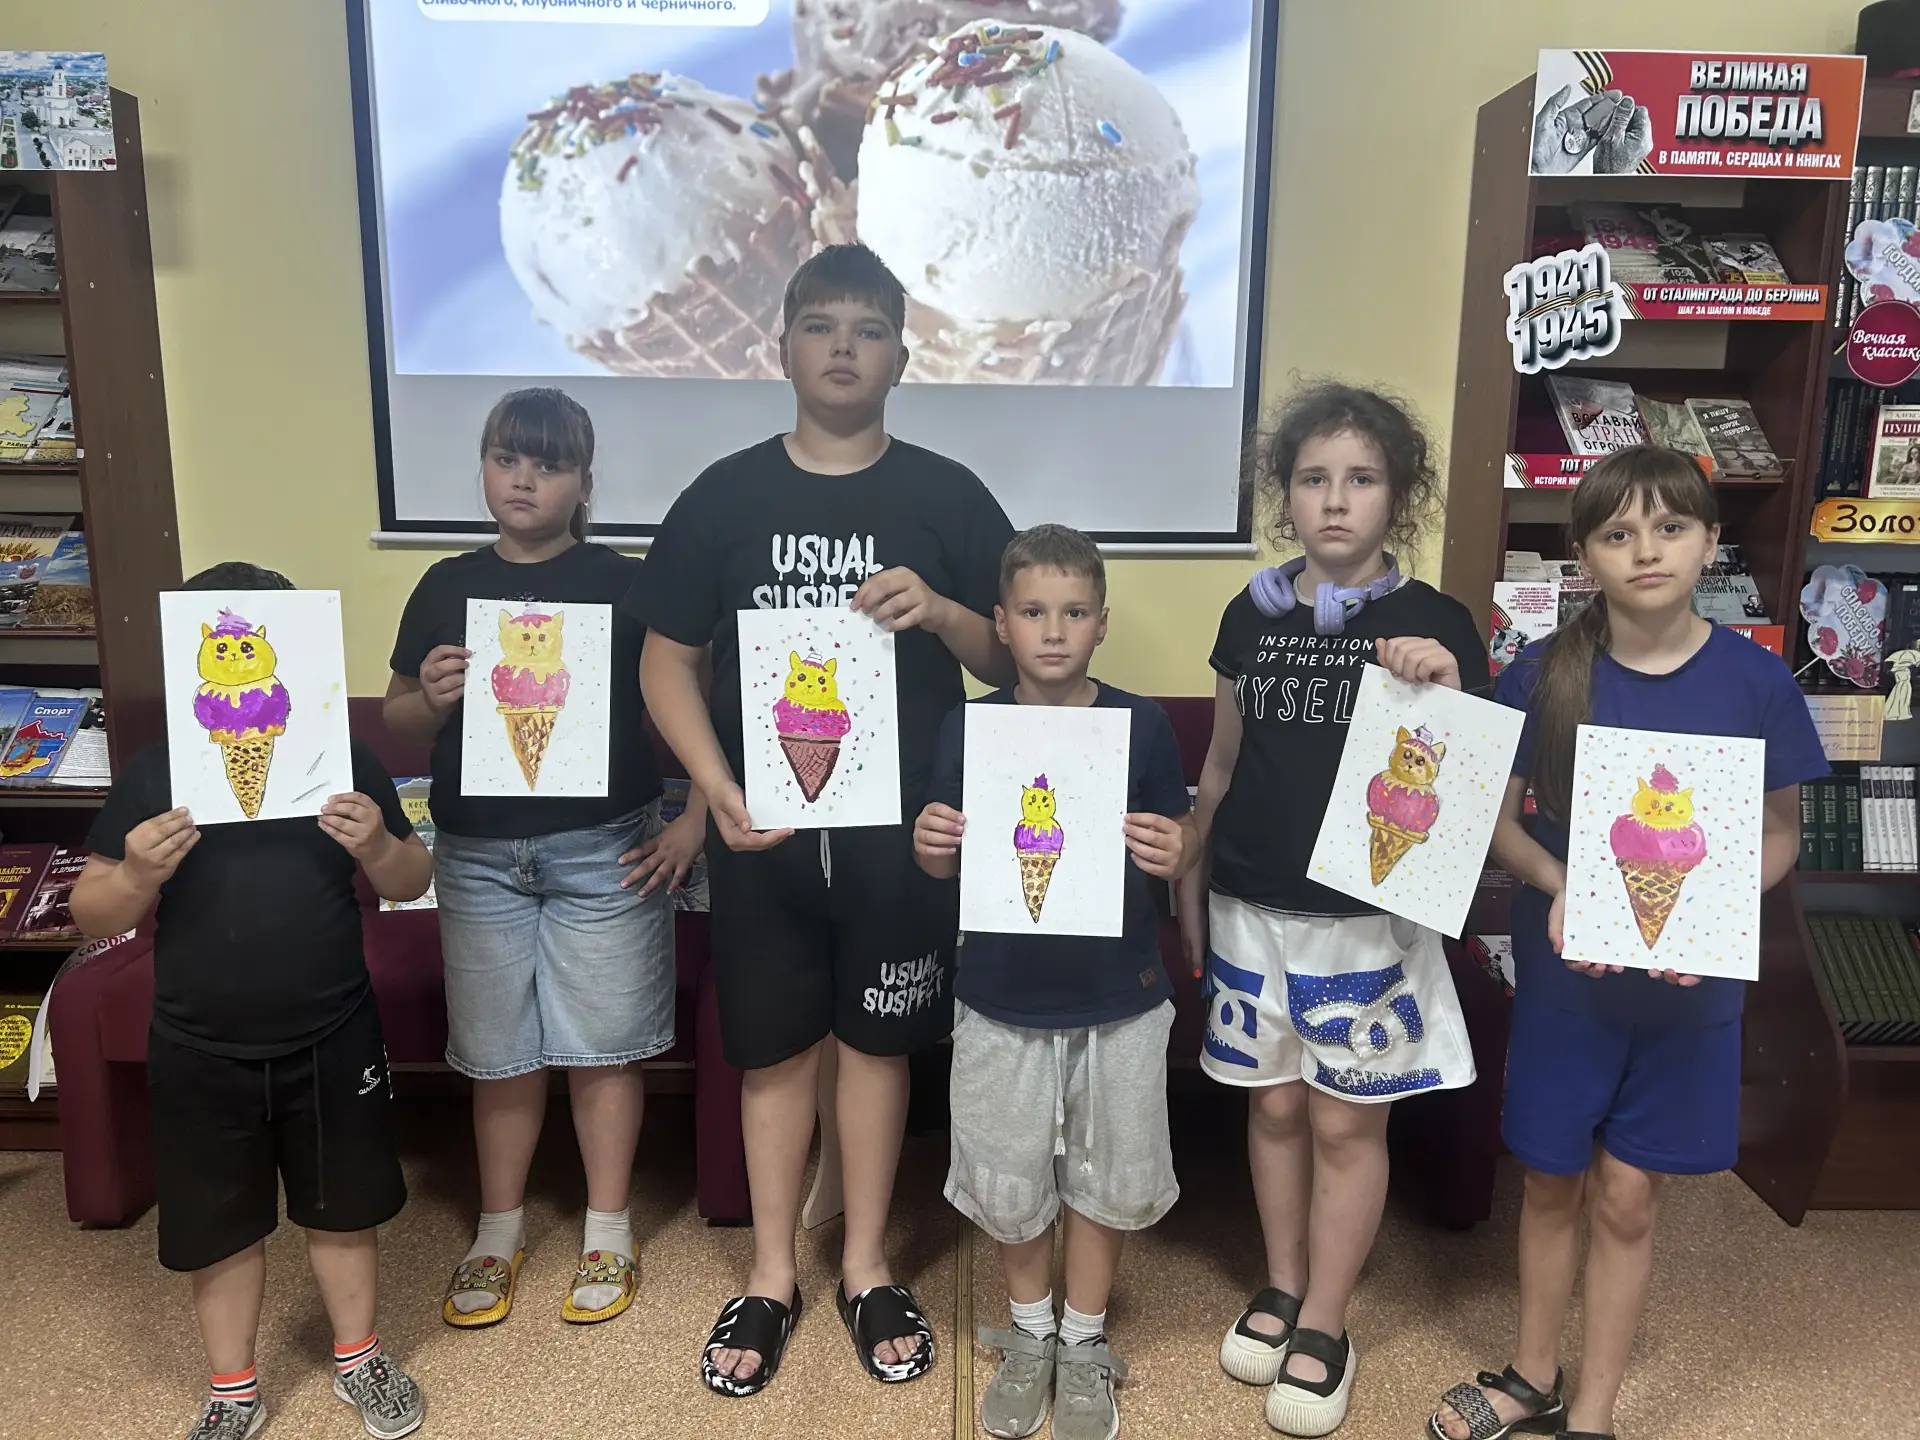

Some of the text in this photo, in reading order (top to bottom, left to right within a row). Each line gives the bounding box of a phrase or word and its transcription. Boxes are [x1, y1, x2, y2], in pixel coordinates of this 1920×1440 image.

[641, 0, 736, 12] черничного.
[1690, 60, 1808, 91] ВЕЛИКАЯ
[1675, 95, 1822, 145] ПОБЕДА
[1659, 151, 1841, 168] В ПАМЯТИ, СЕРДЦАХ И КНИГАХ
[1883, 243, 1920, 292] ГОРДИ
[1511, 252, 1599, 318] 1941
[1643, 288, 1820, 304] ОТ СТАЛИНГРАДА ДО БЕРЛИНА
[1678, 306, 1694, 315] ШАГ
[1696, 306, 1706, 315] ЗА
[1707, 306, 1734, 315] ШАГОМ
[1743, 306, 1771, 316] ПОБЕДЕ
[1515, 299, 1608, 364] 1945
[1853, 330, 1906, 344] Вечная
[1579, 424, 1638, 444] СТРАН
[1560, 458, 1581, 473] ТОТ
[1535, 476, 1567, 485] ИСТОРИЯ
[1831, 504, 1920, 533] Золо
[772, 533, 884, 584] USUAL
[1696, 585, 1748, 594] ЛЕНИНГРАД
[1699, 577, 1732, 587] ОВОРИТ
[752, 582, 859, 609] SUSPE
[1841, 586, 1880, 638] СПАСИБО
[1259, 635, 1374, 650] INSPIRATION
[1257, 651, 1366, 668] OF THE DAY:
[1234, 674, 1352, 723] YSEL
[34, 706, 73, 715] Спорт
[881, 950, 938, 990] USUAL
[863, 967, 945, 1017] SUSPECT
